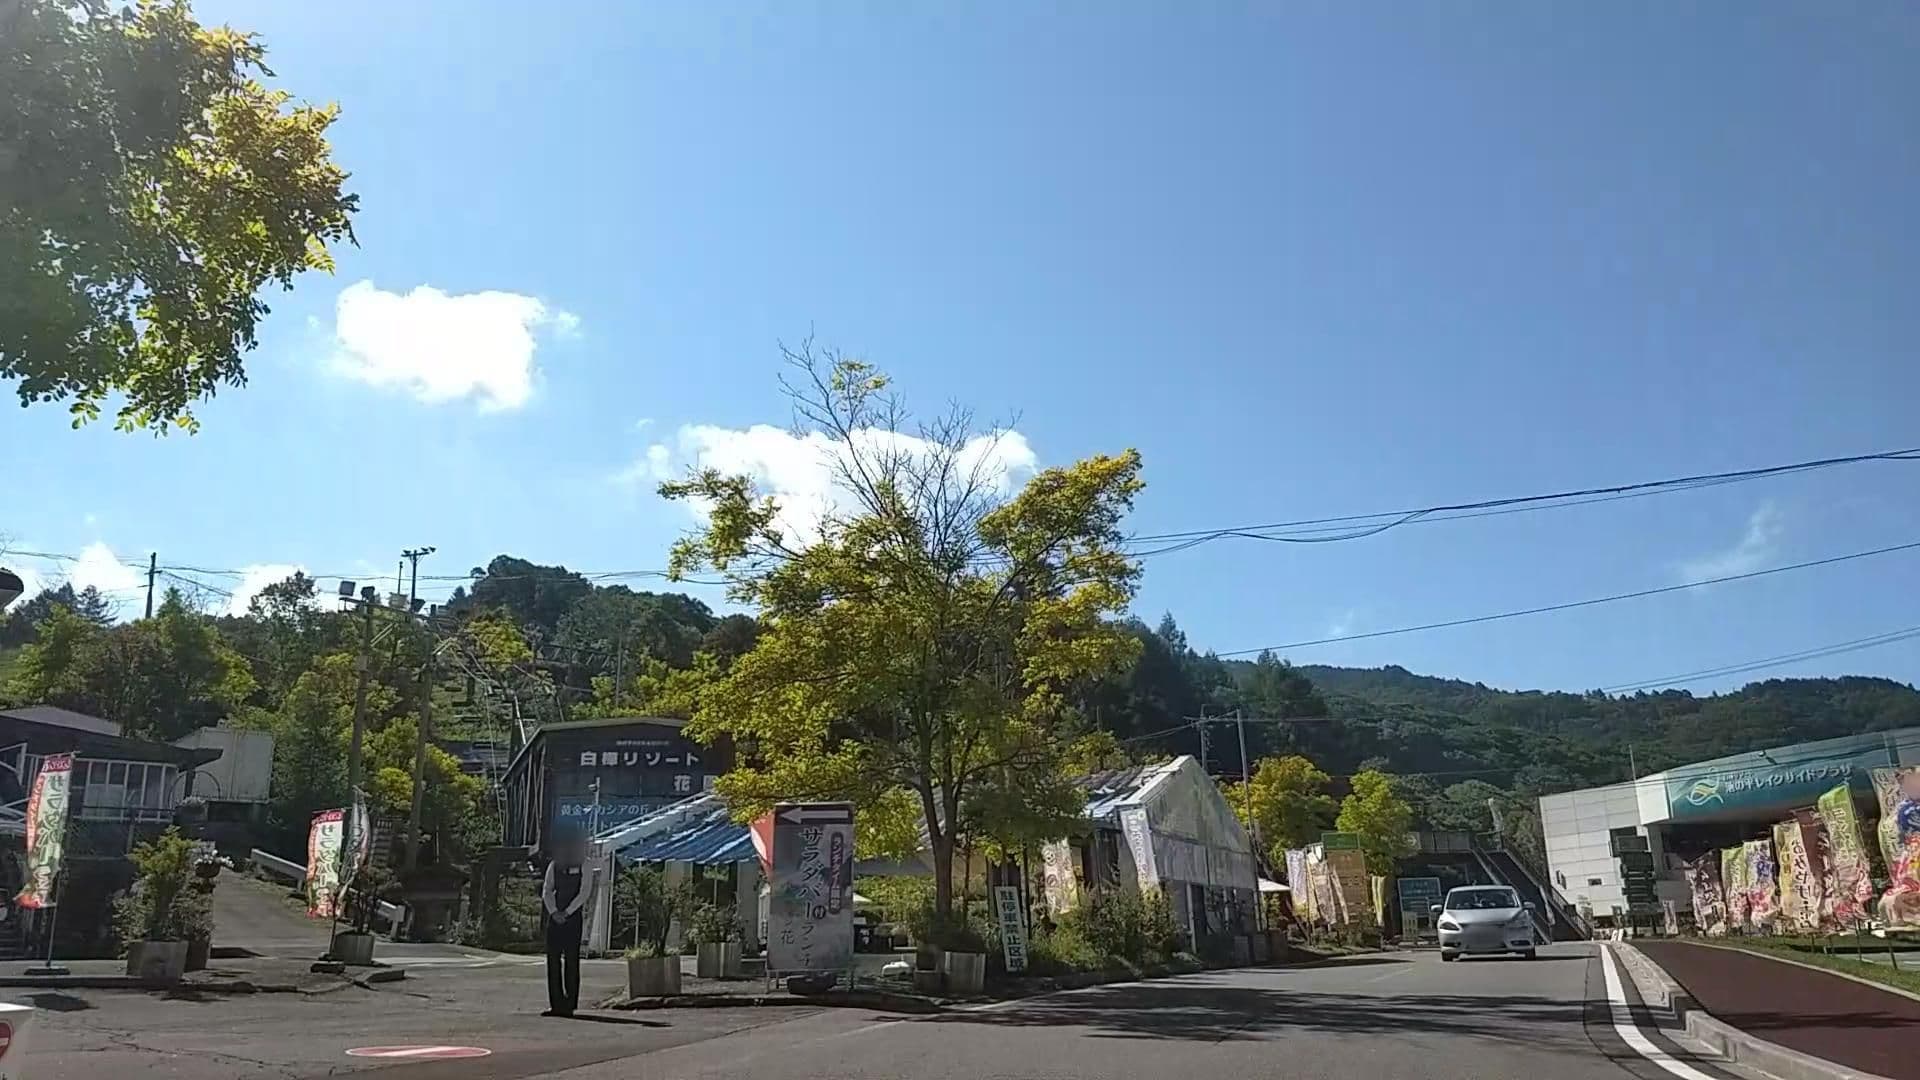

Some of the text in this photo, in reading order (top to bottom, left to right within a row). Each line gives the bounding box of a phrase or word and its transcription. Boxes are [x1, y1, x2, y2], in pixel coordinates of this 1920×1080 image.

[1000, 890, 1025, 969] 駐停車禁止区域
